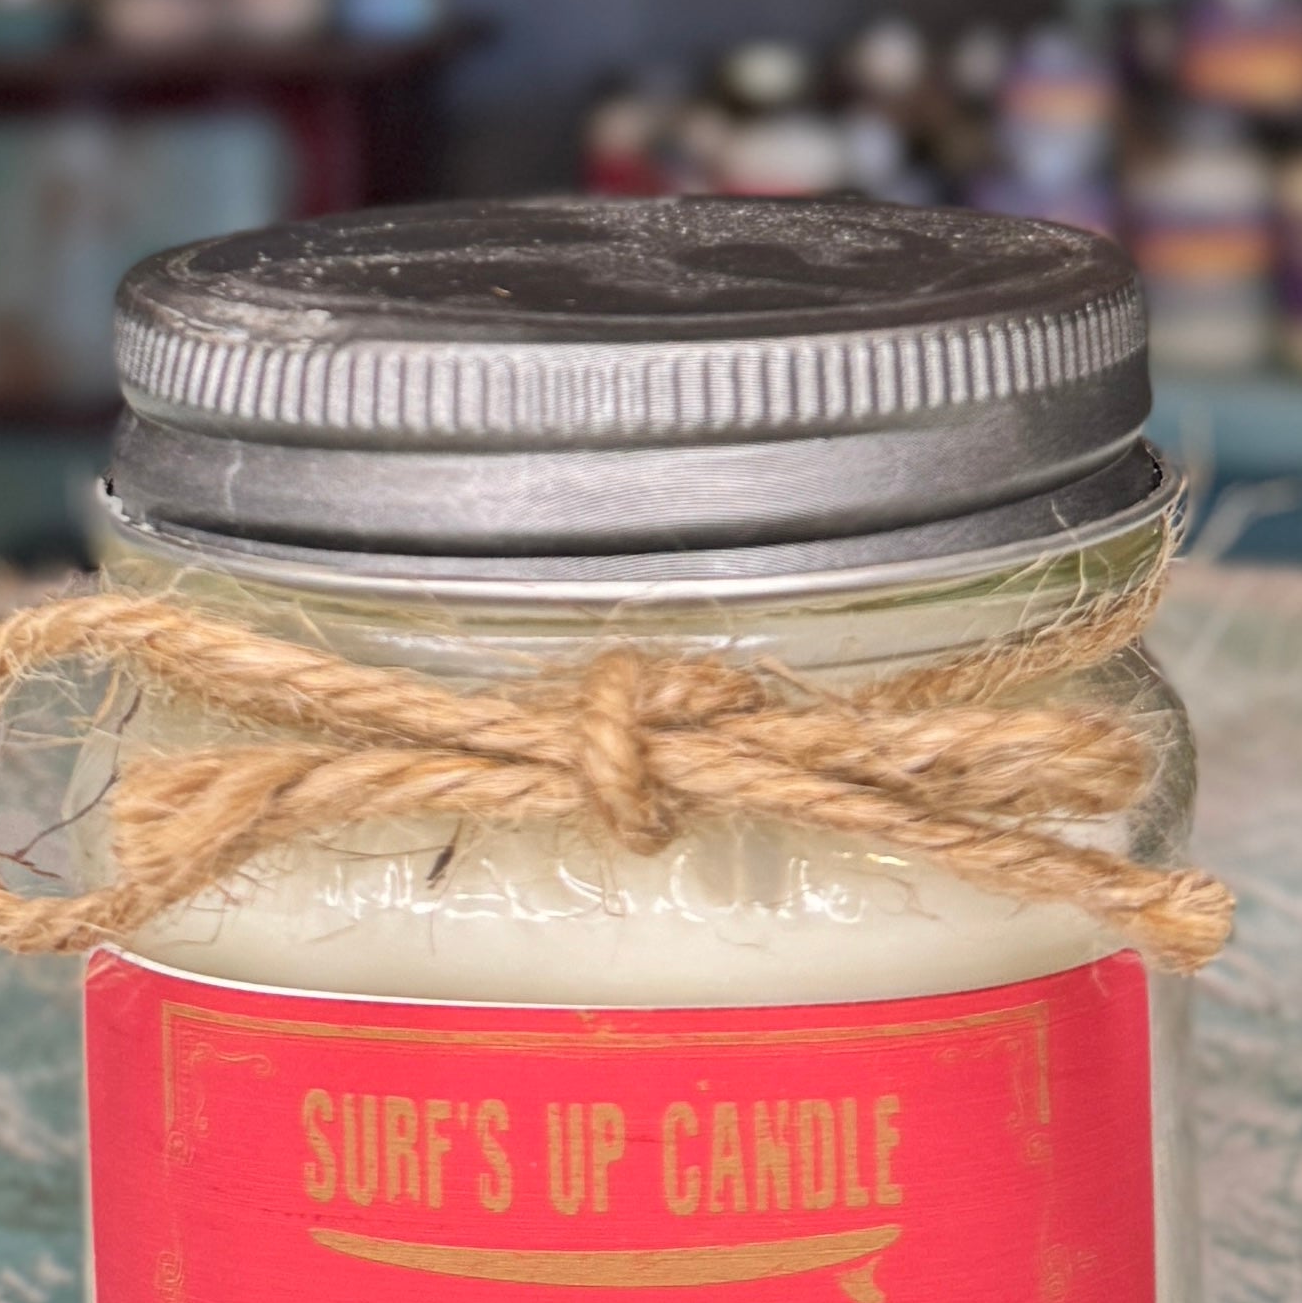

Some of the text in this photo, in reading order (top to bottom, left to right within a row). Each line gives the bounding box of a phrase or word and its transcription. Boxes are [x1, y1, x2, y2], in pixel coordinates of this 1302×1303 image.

[302, 1088, 904, 1217] SURF'S UP CANDLE
